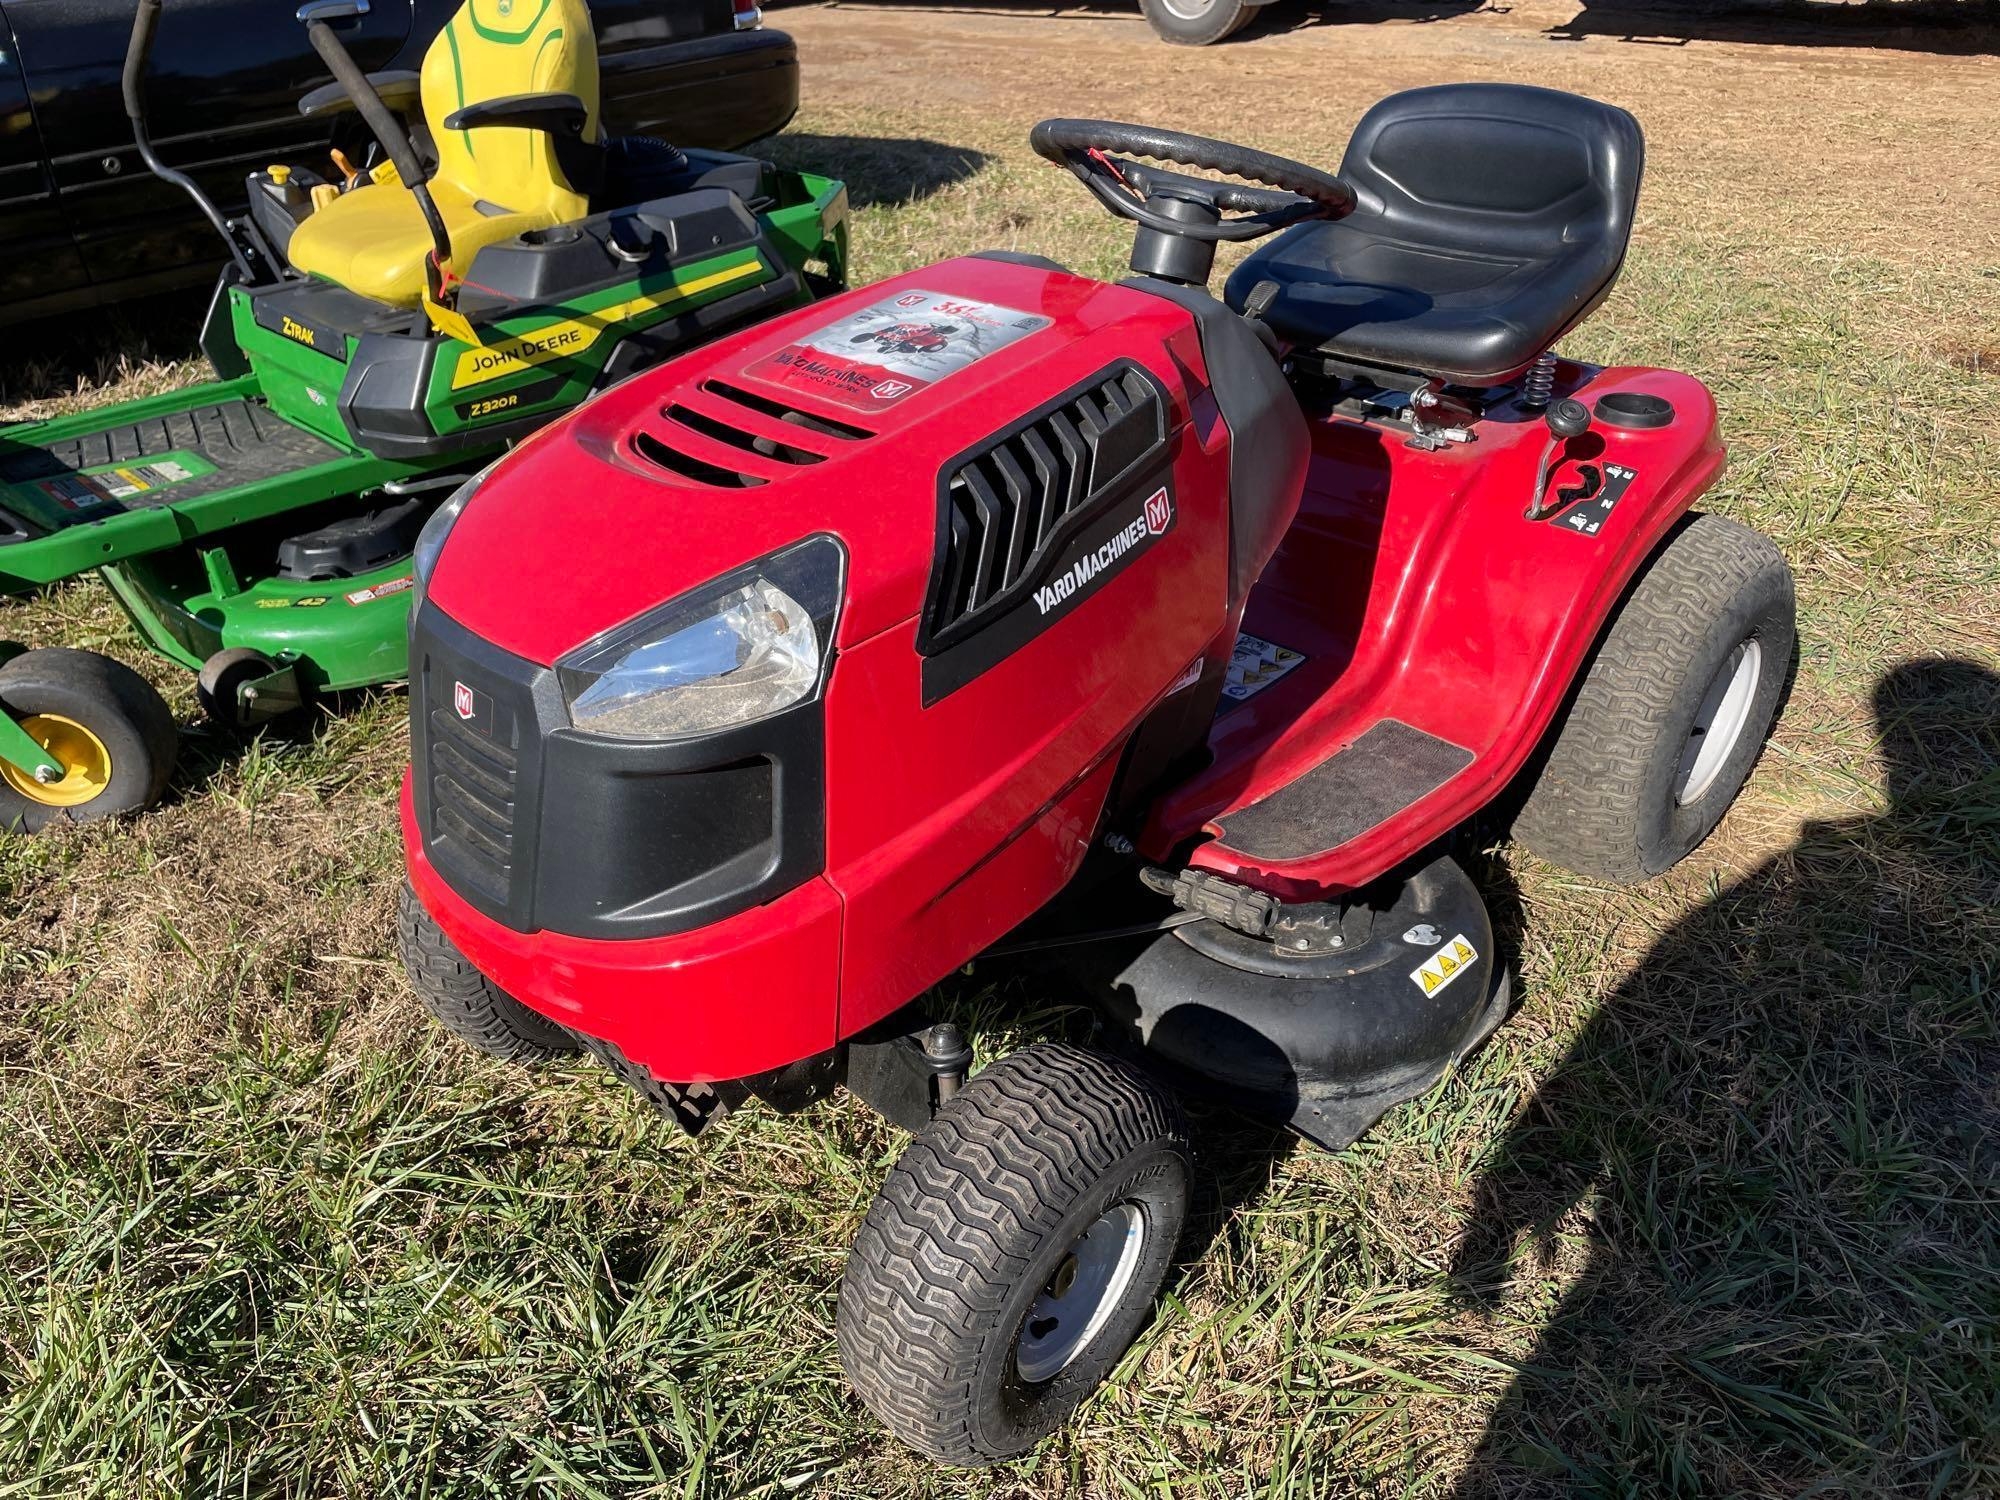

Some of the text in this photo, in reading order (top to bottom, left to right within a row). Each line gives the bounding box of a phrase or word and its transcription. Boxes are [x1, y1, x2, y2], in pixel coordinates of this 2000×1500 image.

[283, 316, 314, 346] ZTRAK
[472, 329, 581, 373] JOHN DEERE
[471, 395, 518, 417] Z320R
[1623, 471, 1634, 480] R
[1600, 499, 1614, 509] N
[1585, 522, 1600, 533] F
[1032, 515, 1148, 615] YARD MACHINES
